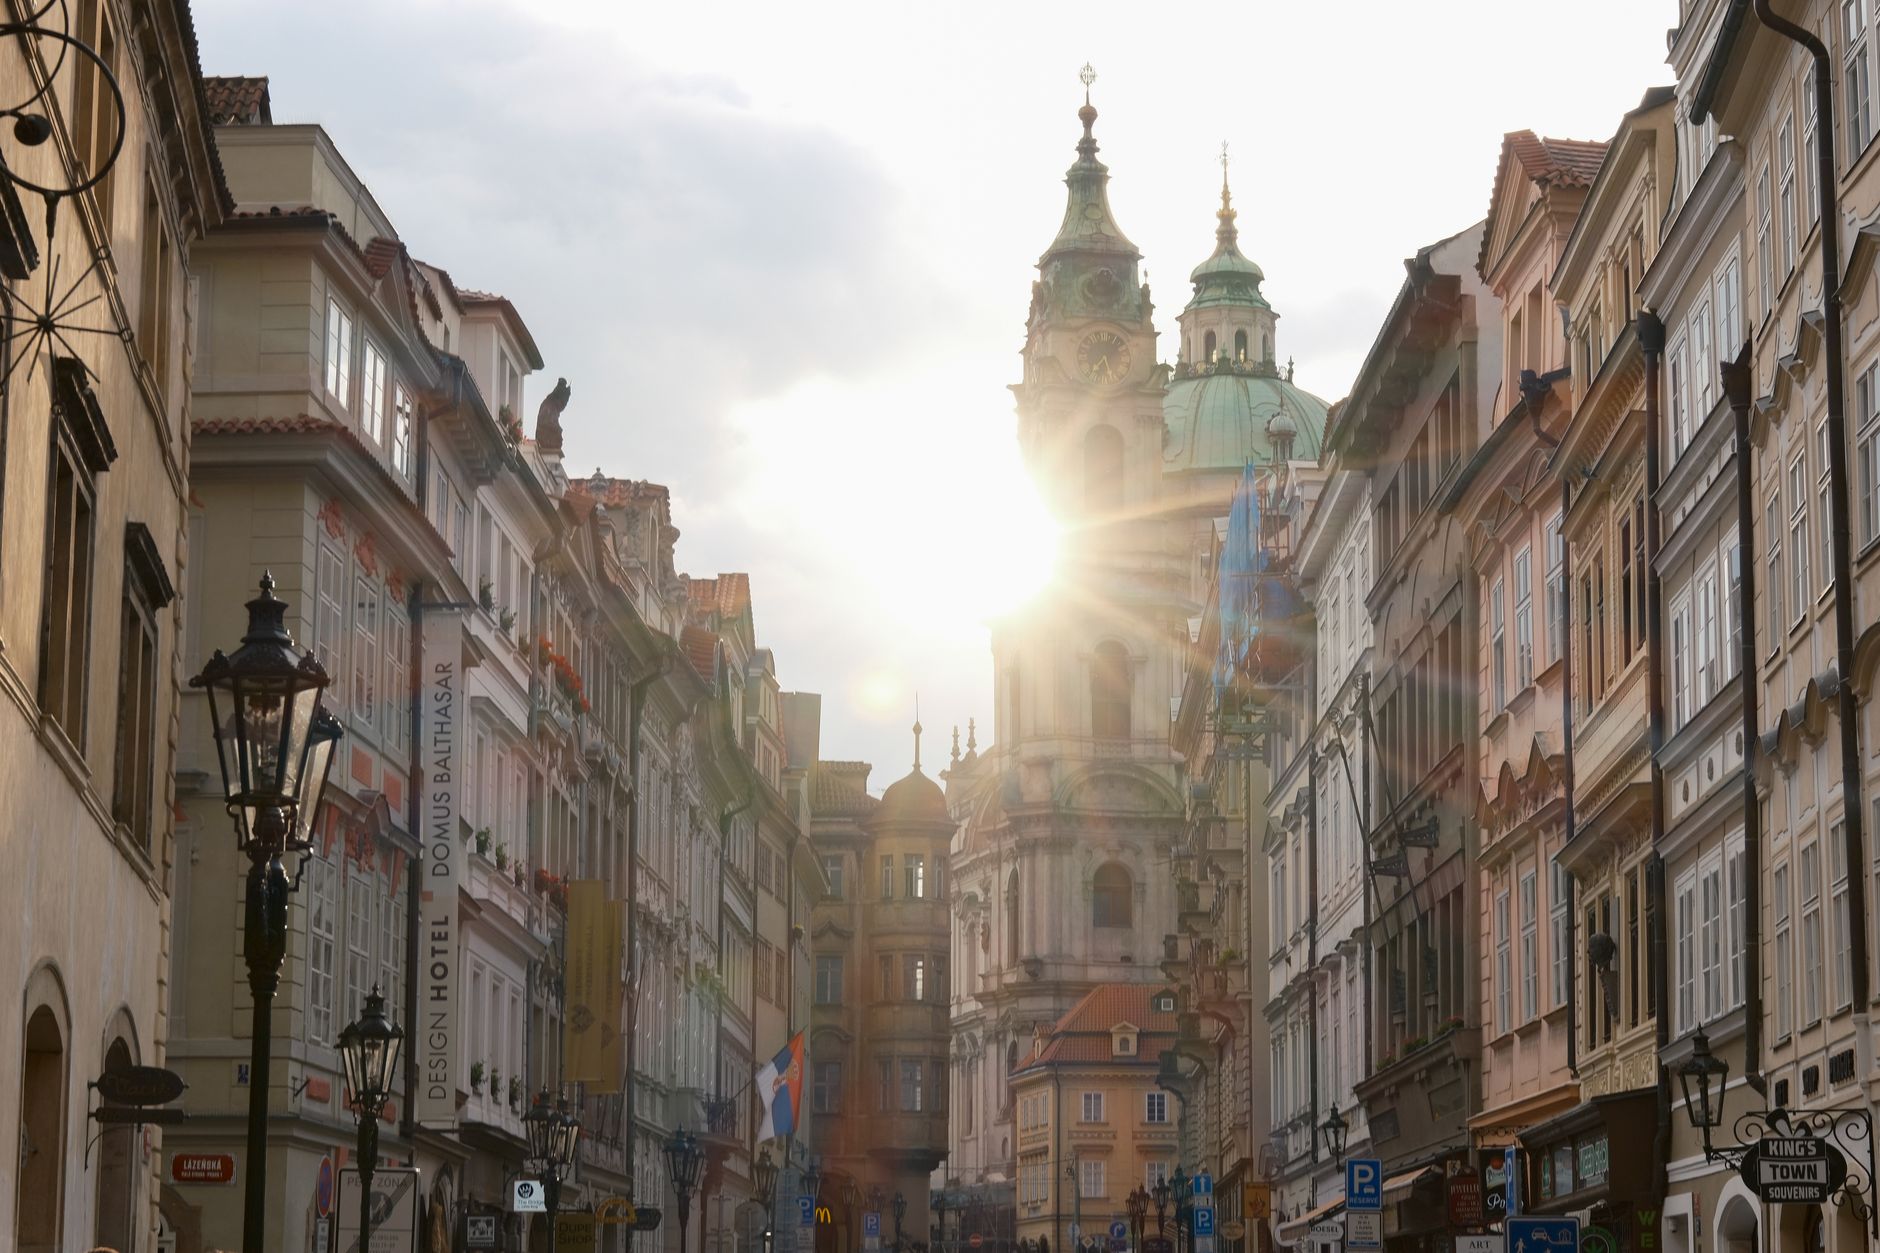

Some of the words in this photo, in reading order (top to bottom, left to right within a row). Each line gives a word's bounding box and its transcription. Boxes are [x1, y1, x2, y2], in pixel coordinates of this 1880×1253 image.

[434, 661, 453, 783] BALTHASAR
[432, 790, 451, 877] DOMUS
[430, 915, 449, 1001] HOTEL
[428, 1012, 447, 1100] DESIGN
[1769, 1140, 1817, 1156] KING'S
[1353, 1164, 1374, 1194] P
[1769, 1163, 1818, 1181] TOWN
[1768, 1186, 1820, 1200] SOUVENIRS
[867, 1215, 877, 1230] P
[1198, 1211, 1209, 1227] P
[559, 1234, 592, 1245] SHOP
[1469, 1240, 1491, 1249] ART
